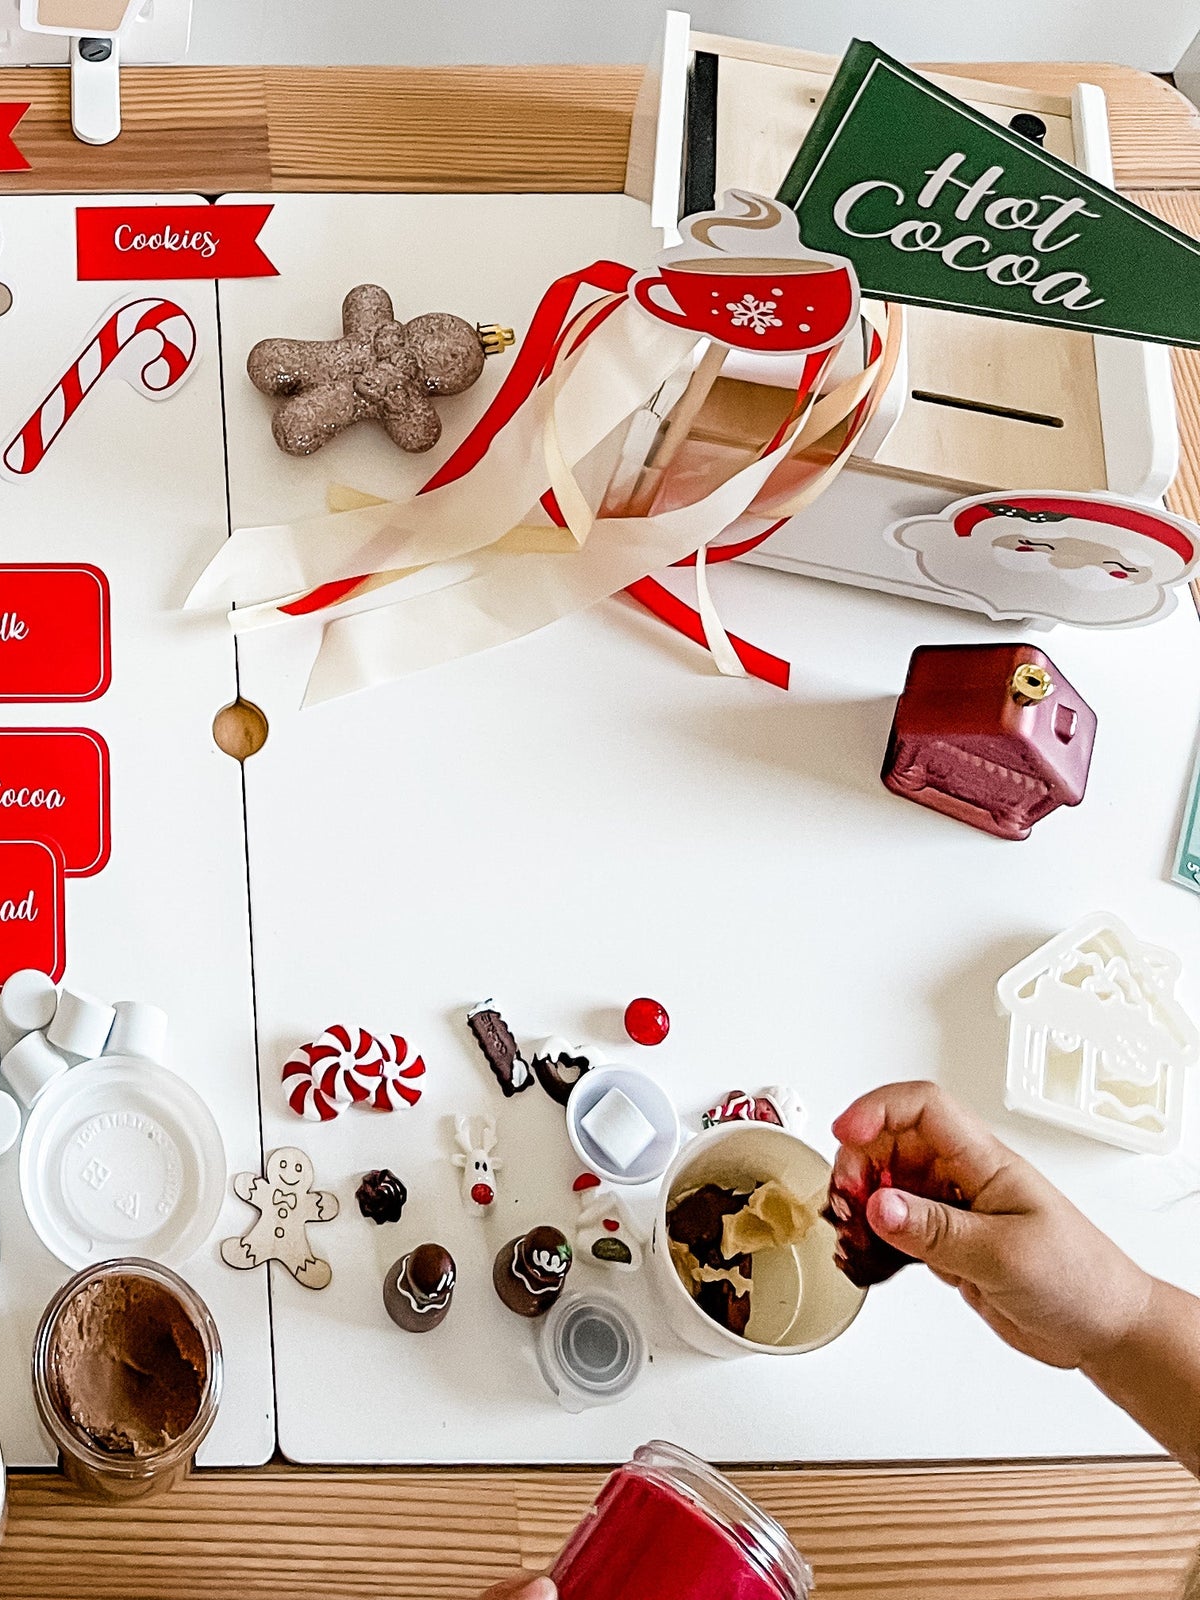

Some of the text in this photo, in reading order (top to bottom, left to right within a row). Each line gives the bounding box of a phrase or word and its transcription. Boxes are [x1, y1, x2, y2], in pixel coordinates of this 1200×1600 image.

[114, 224, 220, 258] Cookies
[833, 180, 1106, 311] Cocoa
[924, 152, 1101, 253] Hot
